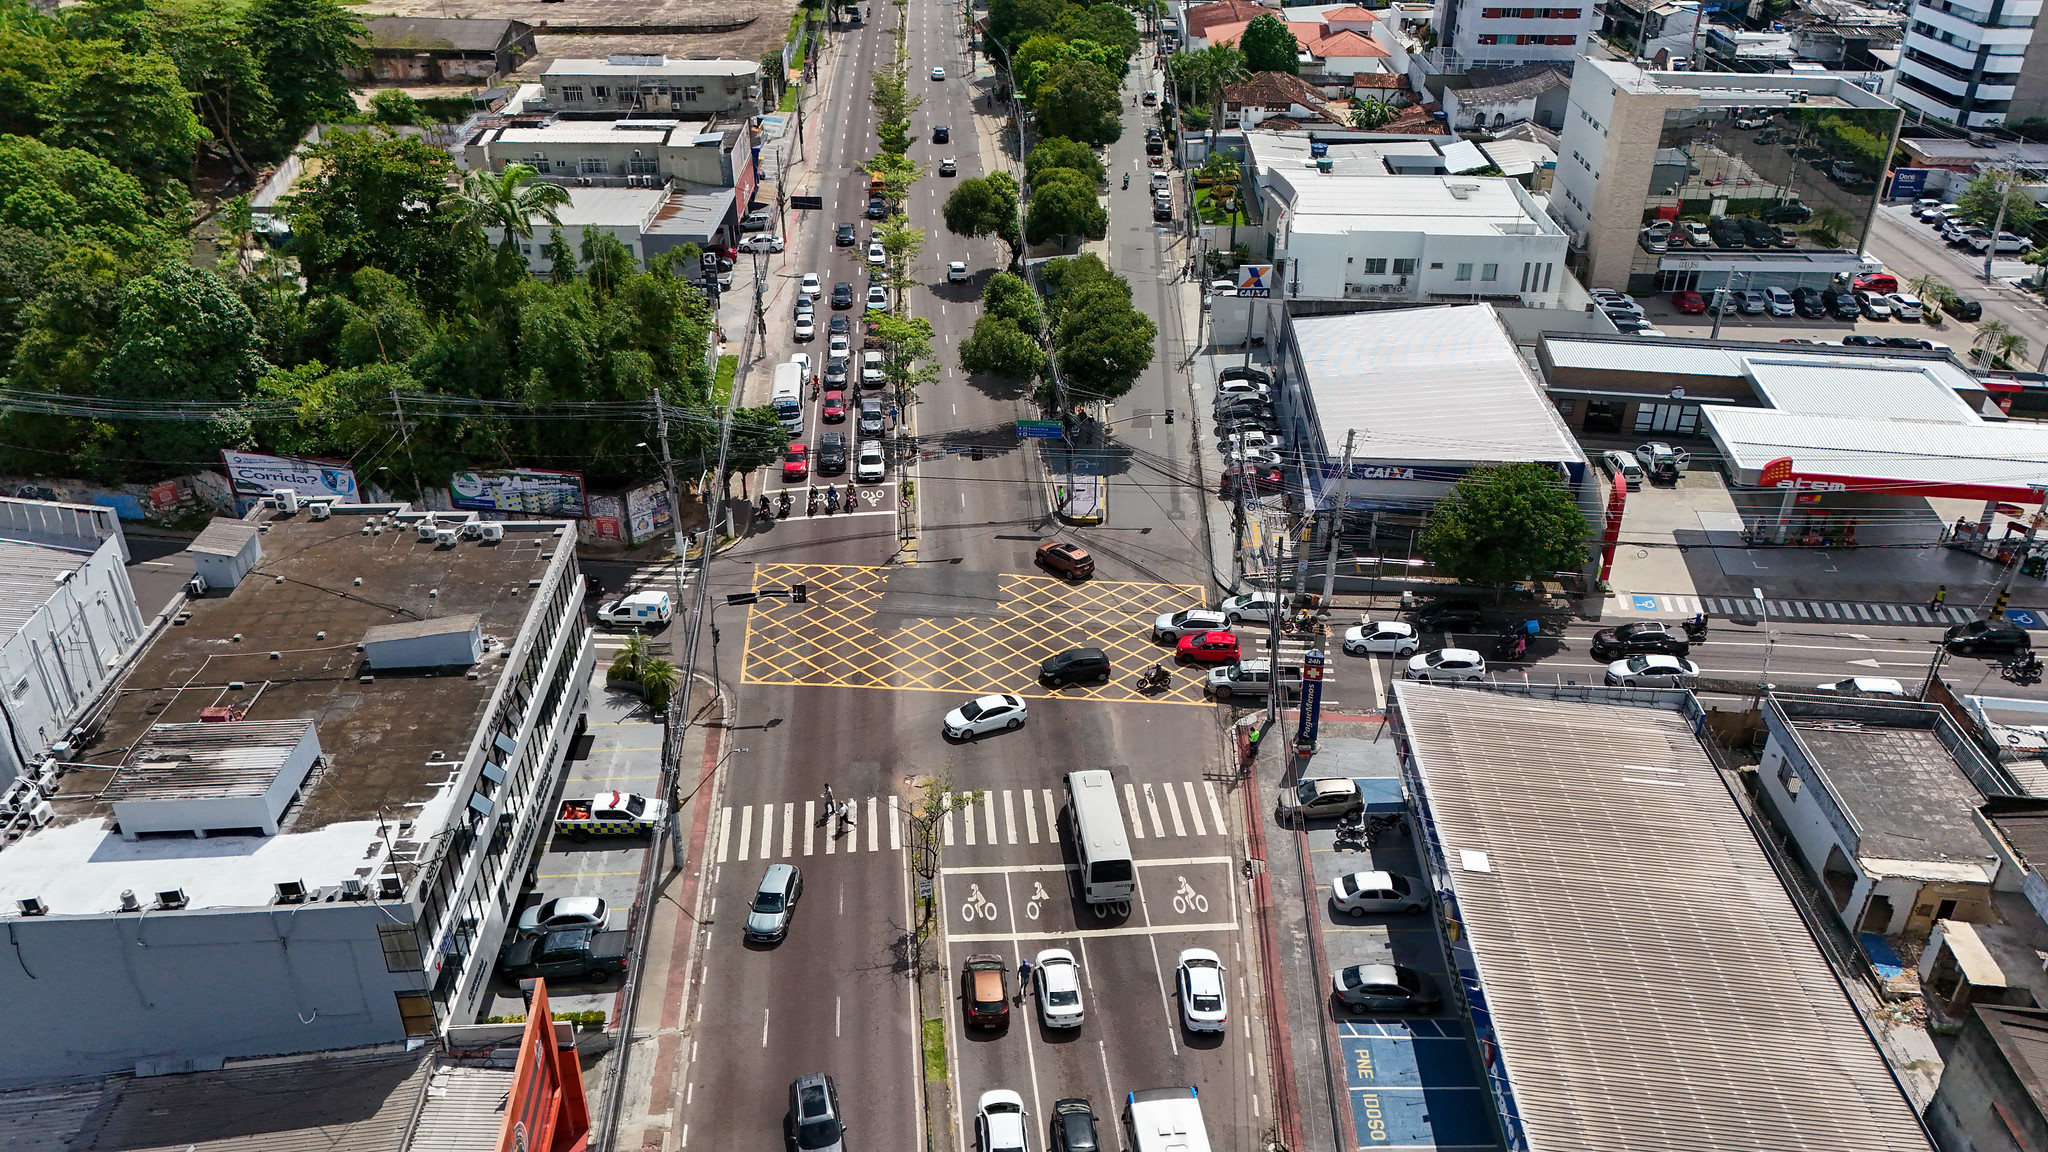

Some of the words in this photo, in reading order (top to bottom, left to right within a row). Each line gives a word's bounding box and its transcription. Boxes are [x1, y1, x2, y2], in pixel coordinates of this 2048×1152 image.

[1240, 289, 1268, 297] CAIXA
[238, 469, 318, 485] Corrida?
[1364, 467, 1414, 479] CAIXA
[1776, 477, 1846, 492] atem
[1354, 1049, 1374, 1079] PNE
[1362, 1093, 1387, 1141] IDOSO
